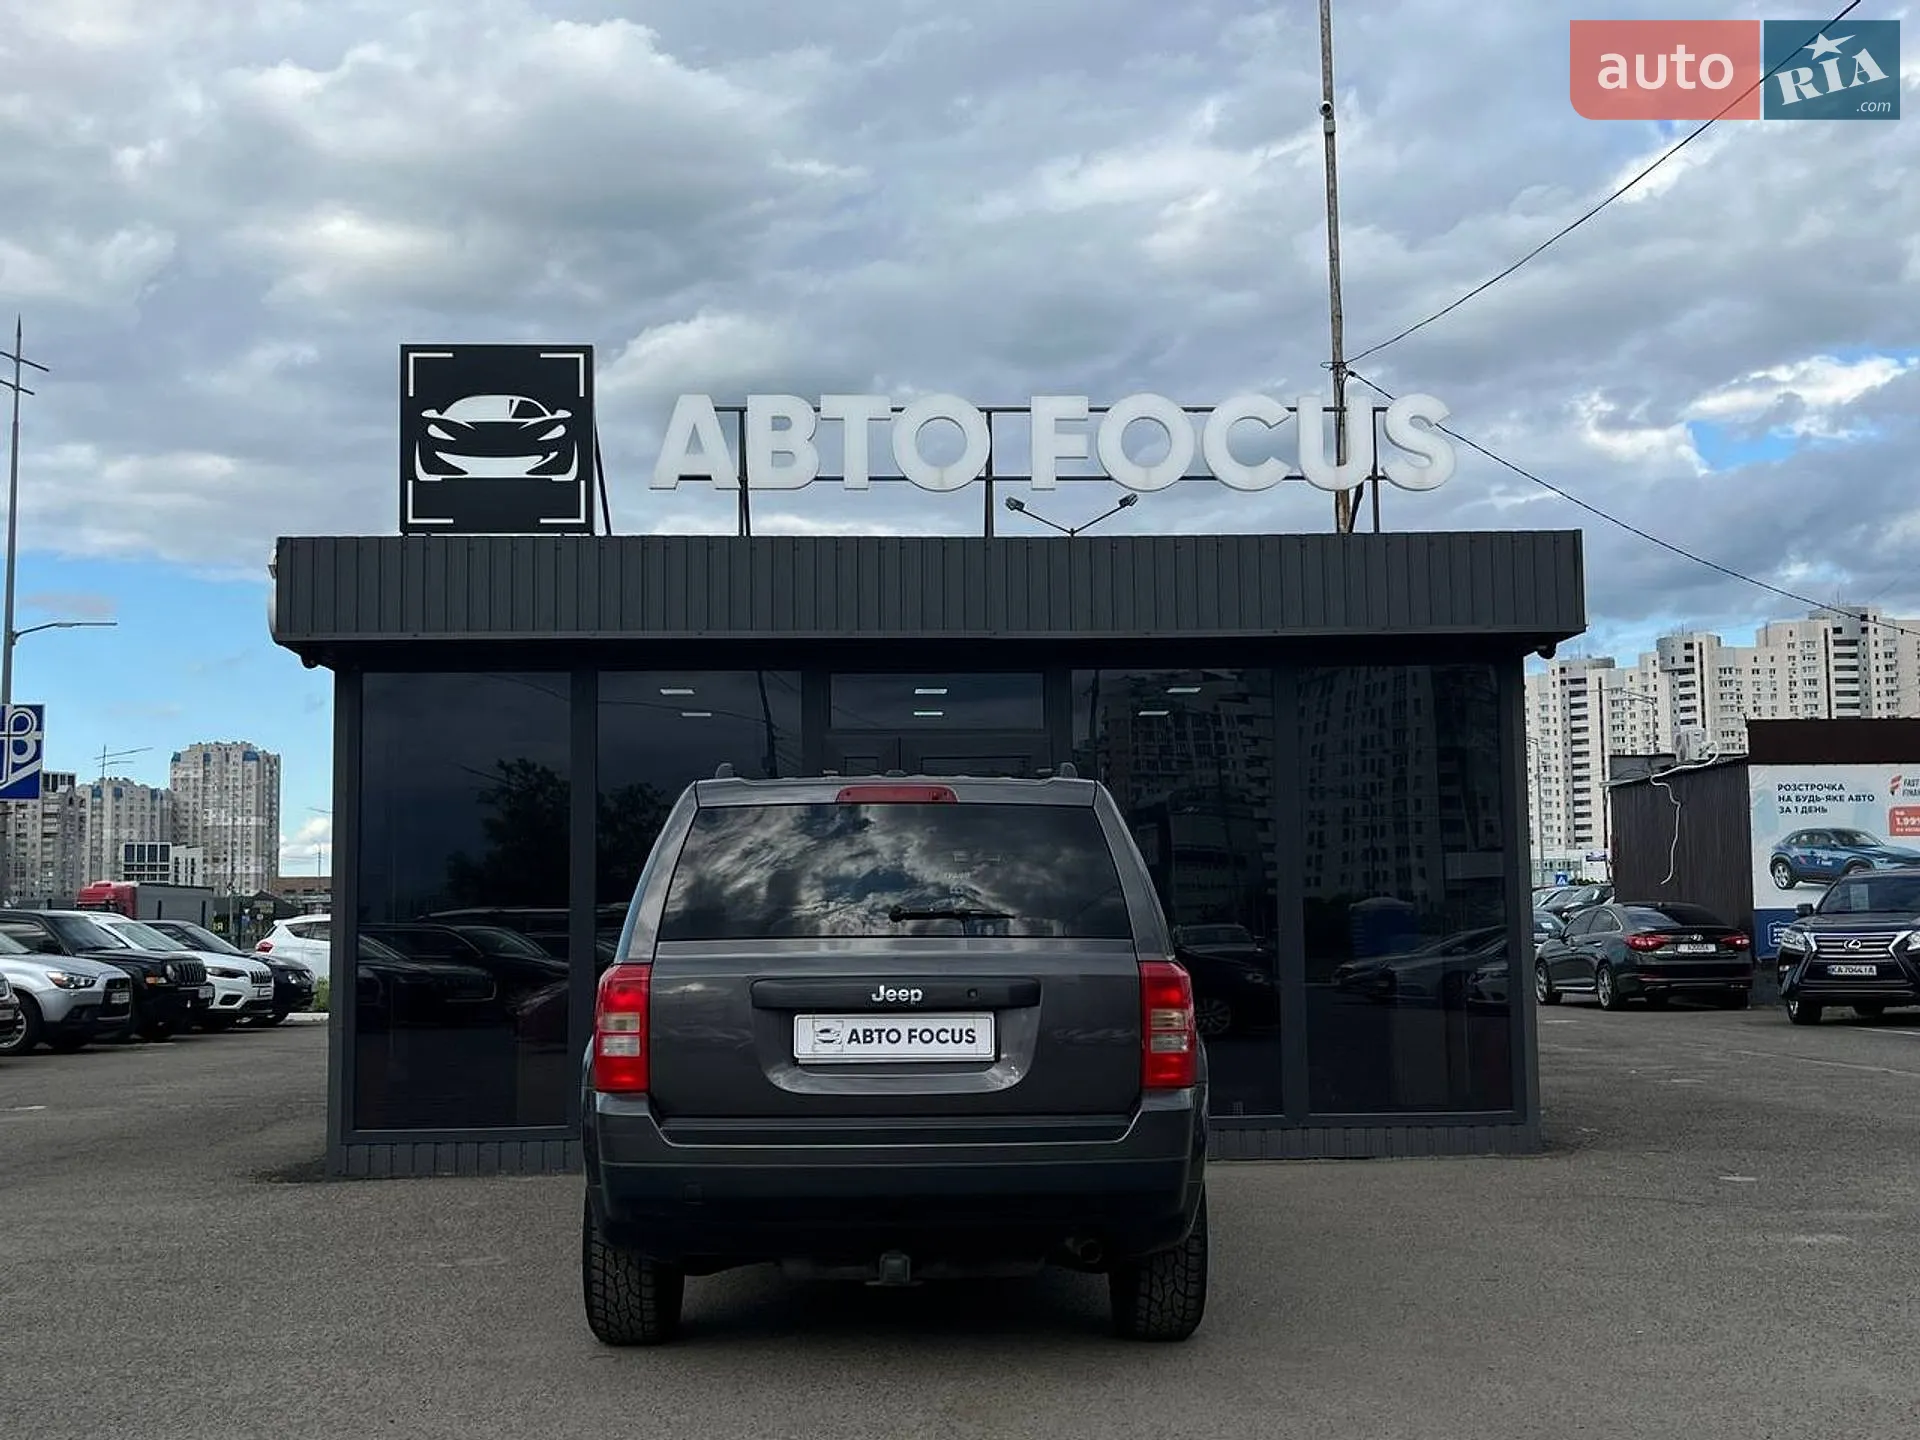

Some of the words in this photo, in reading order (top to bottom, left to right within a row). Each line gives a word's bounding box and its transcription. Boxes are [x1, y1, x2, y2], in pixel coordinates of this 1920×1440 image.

[648, 393, 991, 493] АВТО
[1030, 393, 1457, 492] FOCUS
[1777, 783, 1845, 792] РОЗСТРОЧКА
[1778, 794, 1793, 802] НА
[1795, 794, 1845, 803] БУДЬ-ЯКЕ
[1847, 794, 1875, 802] АВТО
[1779, 805, 1792, 814] ЗА
[1800, 805, 1828, 815] ДЕНЬ
[871, 984, 923, 1005] Jeep
[846, 1028, 901, 1045] АВТО
[907, 1028, 976, 1045] FOCUS
